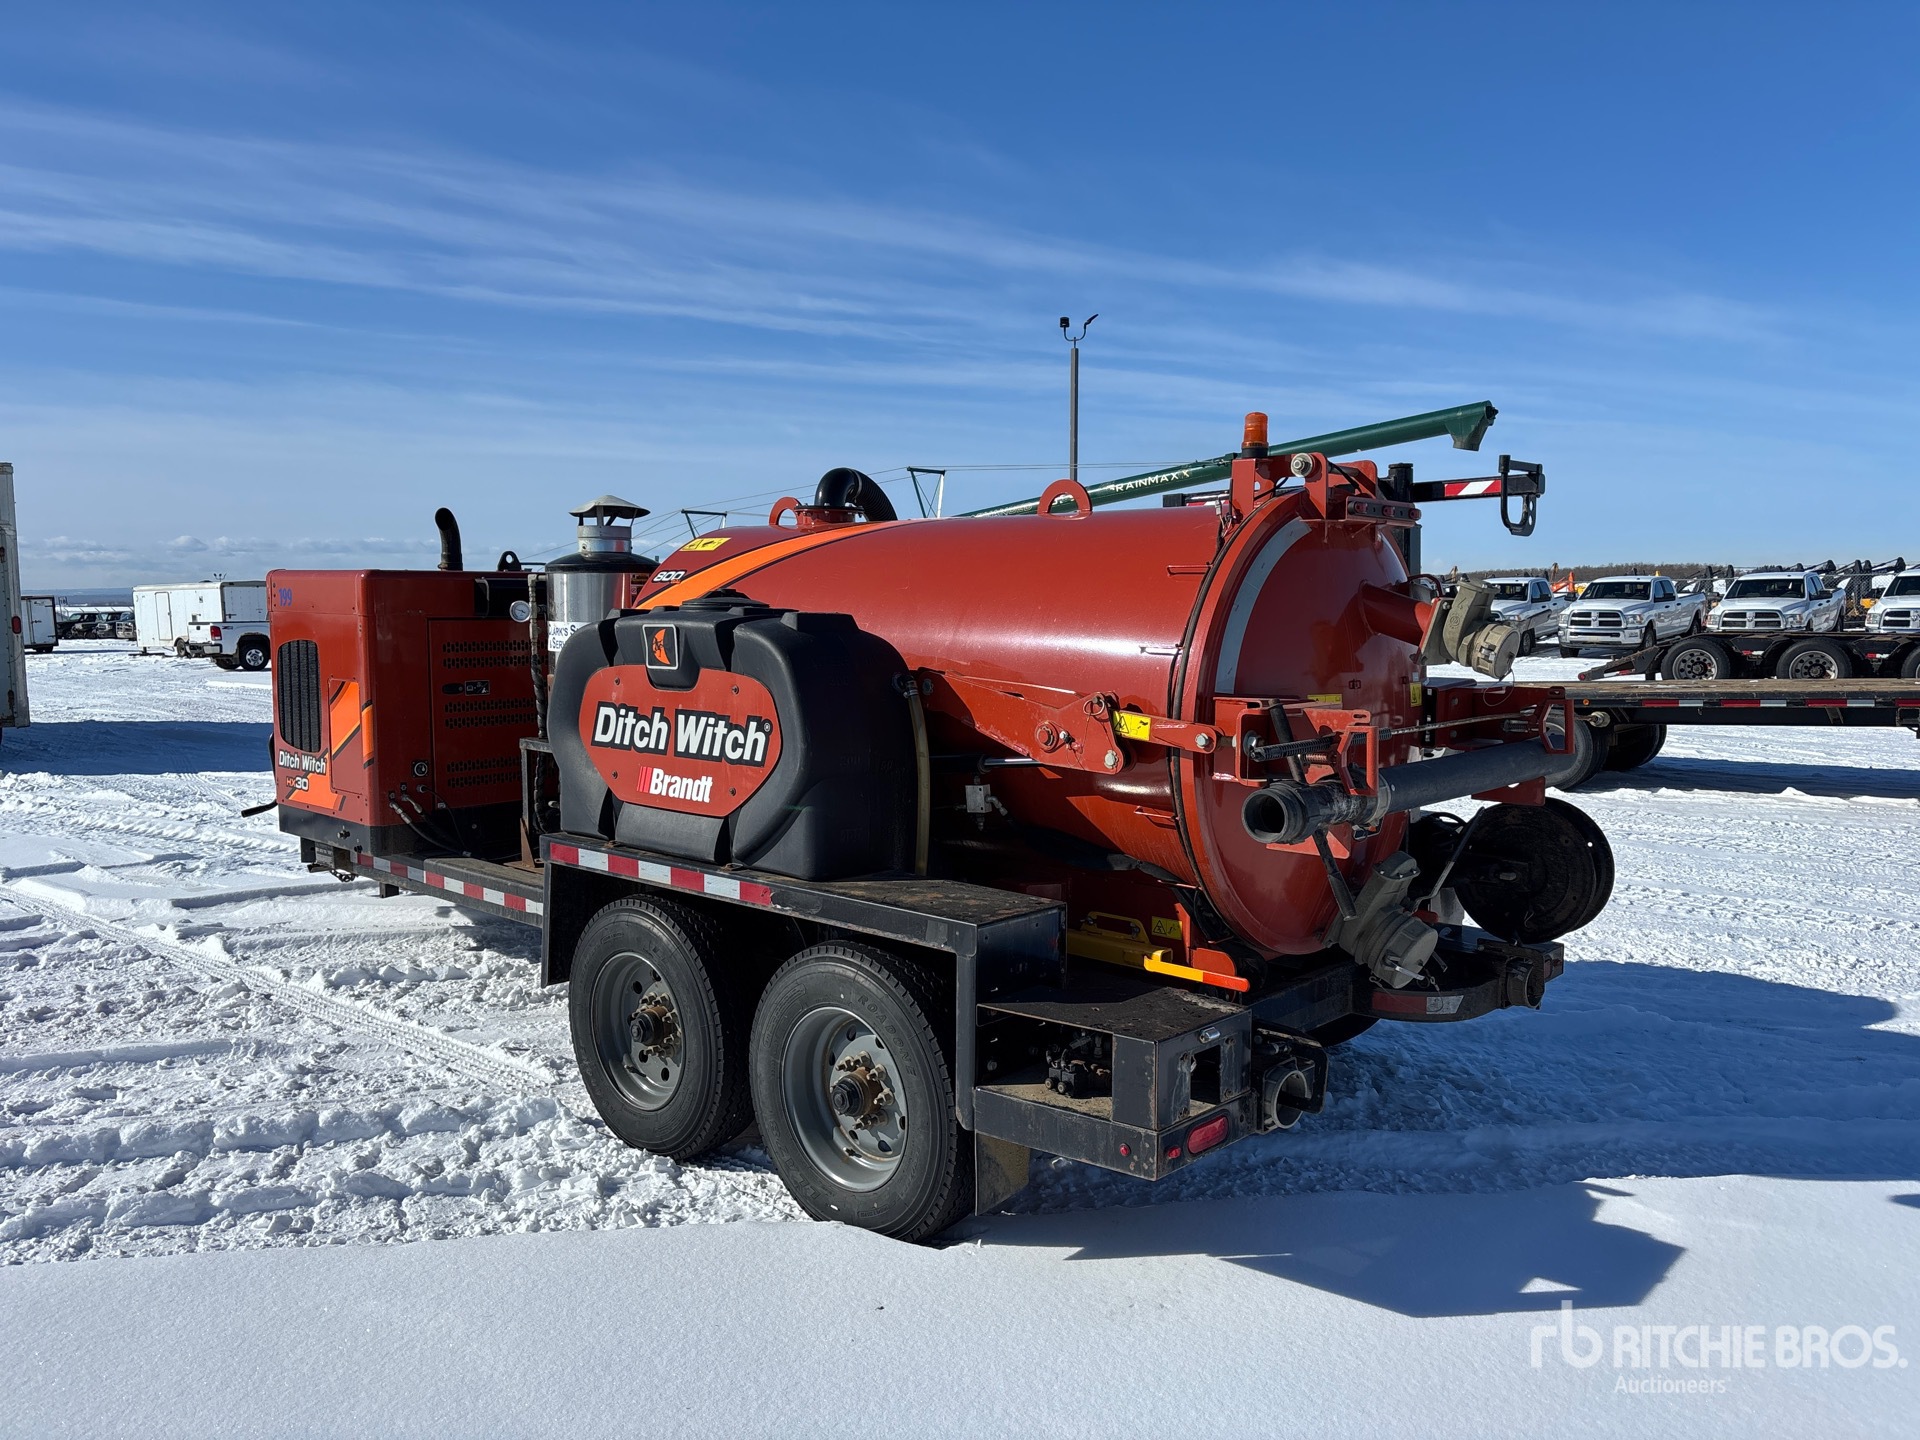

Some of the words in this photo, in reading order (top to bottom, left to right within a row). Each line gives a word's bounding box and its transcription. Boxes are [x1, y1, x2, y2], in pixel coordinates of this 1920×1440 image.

[653, 571, 685, 582] 800
[279, 588, 292, 606] 199
[594, 706, 669, 750] Ditch
[279, 750, 300, 769] Ditch
[286, 776, 309, 791] HX30
[650, 768, 713, 803] Brandt
[857, 992, 918, 1079] ROADONE
